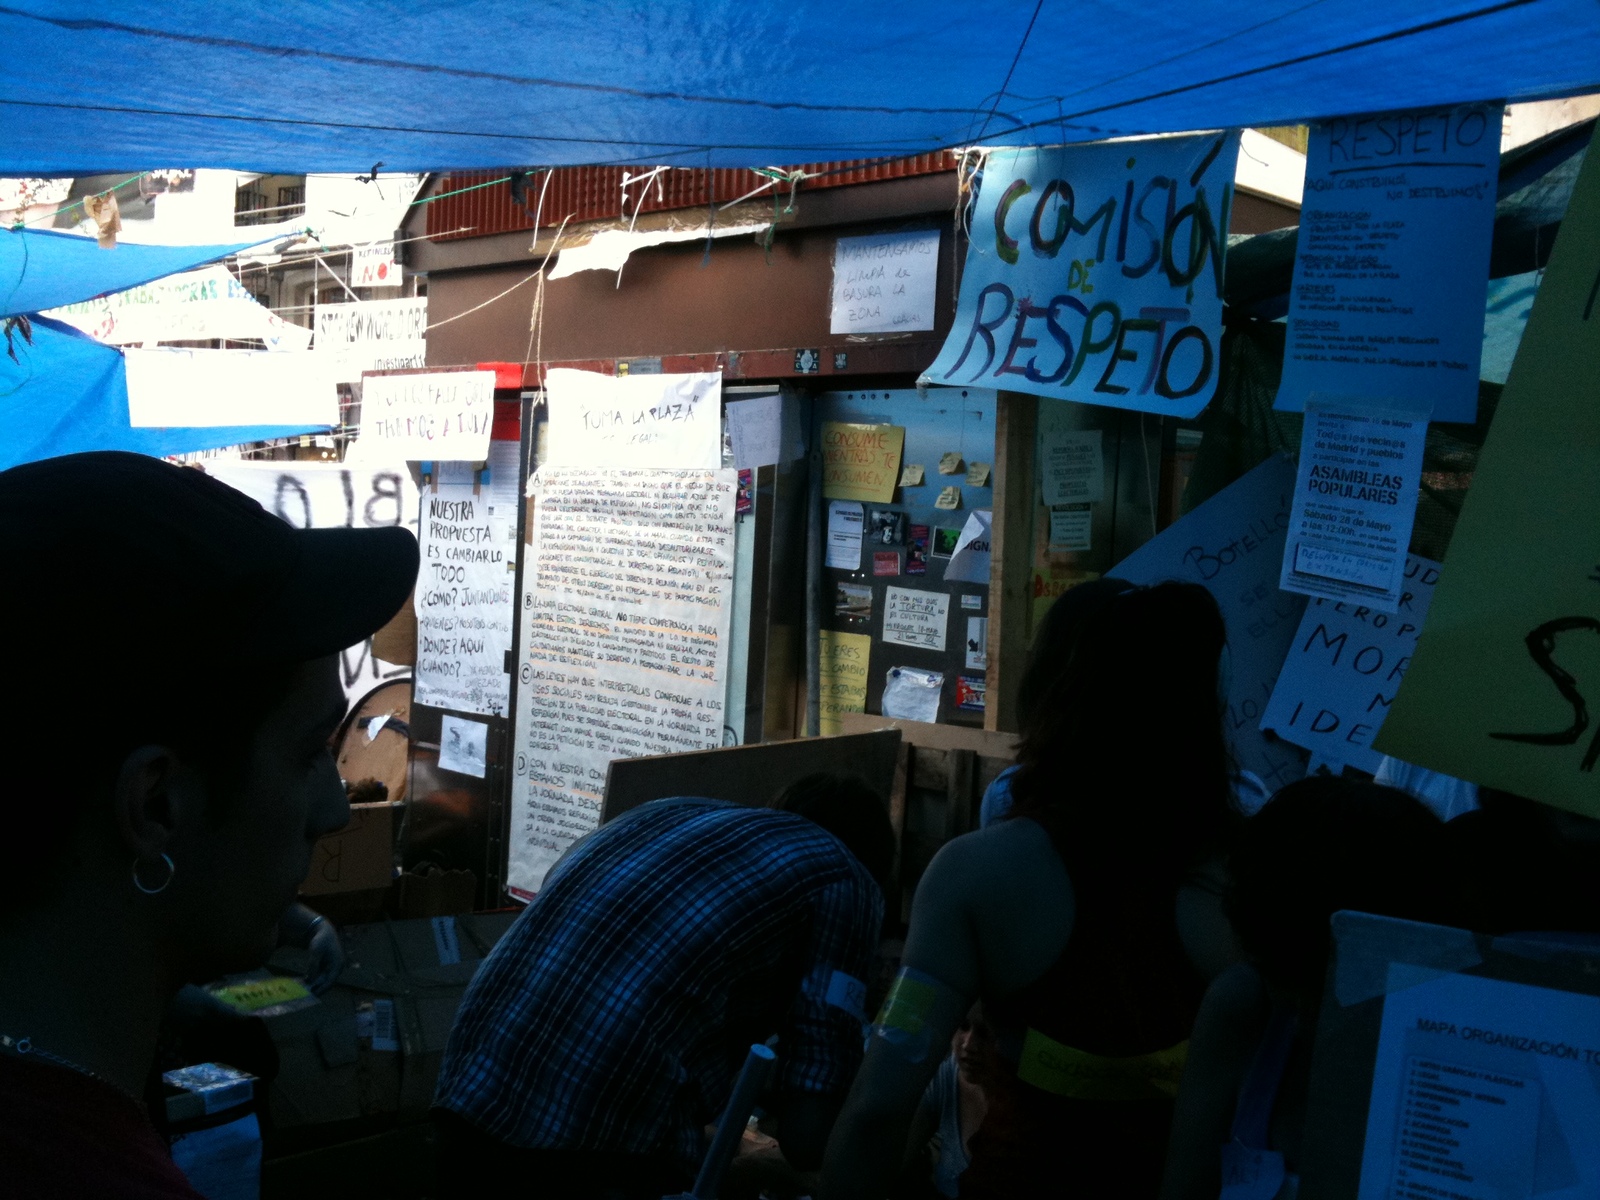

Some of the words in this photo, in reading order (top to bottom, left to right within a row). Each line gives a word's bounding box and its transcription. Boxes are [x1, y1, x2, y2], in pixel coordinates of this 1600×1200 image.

[1328, 111, 1487, 162] RESPETO
[1066, 259, 1095, 295] DE
[944, 283, 1214, 401] RESPETO
[825, 430, 889, 449] CONSUME
[1368, 436, 1406, 448] vecin@s
[1315, 441, 1325, 449] de
[1328, 442, 1359, 453] Madrid
[1367, 448, 1404, 460] pueblos
[1310, 465, 1403, 490] ASAMBLEAS
[1308, 479, 1399, 505] POPULARES
[430, 498, 475, 522] NUESTRA
[1309, 520, 1322, 530] las
[1339, 515, 1351, 525] 28
[1353, 517, 1364, 527] de
[1367, 519, 1392, 532] Mayo
[430, 522, 492, 544] PROPUESTA
[427, 545, 441, 558] ES
[446, 548, 503, 563] CAMBIARLO
[432, 562, 465, 583] TODO
[900, 602, 934, 613] TORTURA
[557, 614, 576, 624] ESTOS
[558, 603, 586, 614] ELECTORAL
[616, 612, 627, 621] NO
[649, 617, 693, 632] COMPETENCIA
[698, 625, 717, 638] PARA
[900, 613, 928, 622] CULTURA
[671, 654, 680, 662] EL
[706, 659, 715, 667] DE
[833, 645, 860, 659] ERES
[687, 669, 694, 677] LA
[832, 664, 865, 676] CAMBIO
[533, 671, 545, 680] LAS
[546, 672, 566, 682] LEYES
[568, 676, 579, 684] HAY
[582, 677, 594, 687] QUE
[598, 679, 651, 697] INTERPRETARLAS
[655, 690, 692, 705] CONFORME
[707, 701, 722, 710] LOS
[607, 710, 642, 722] ELECTORAL
[667, 721, 700, 734] JORNADA
[706, 728, 717, 737] DE
[530, 758, 546, 771] CON
[552, 761, 584, 776] NUESTRA
[529, 771, 566, 788] ESTAMOS
[540, 788, 574, 806] JORNADA
[1416, 1018, 1458, 1036] MAPA
[1461, 1026, 1579, 1060] ORGANIZACIÓN
